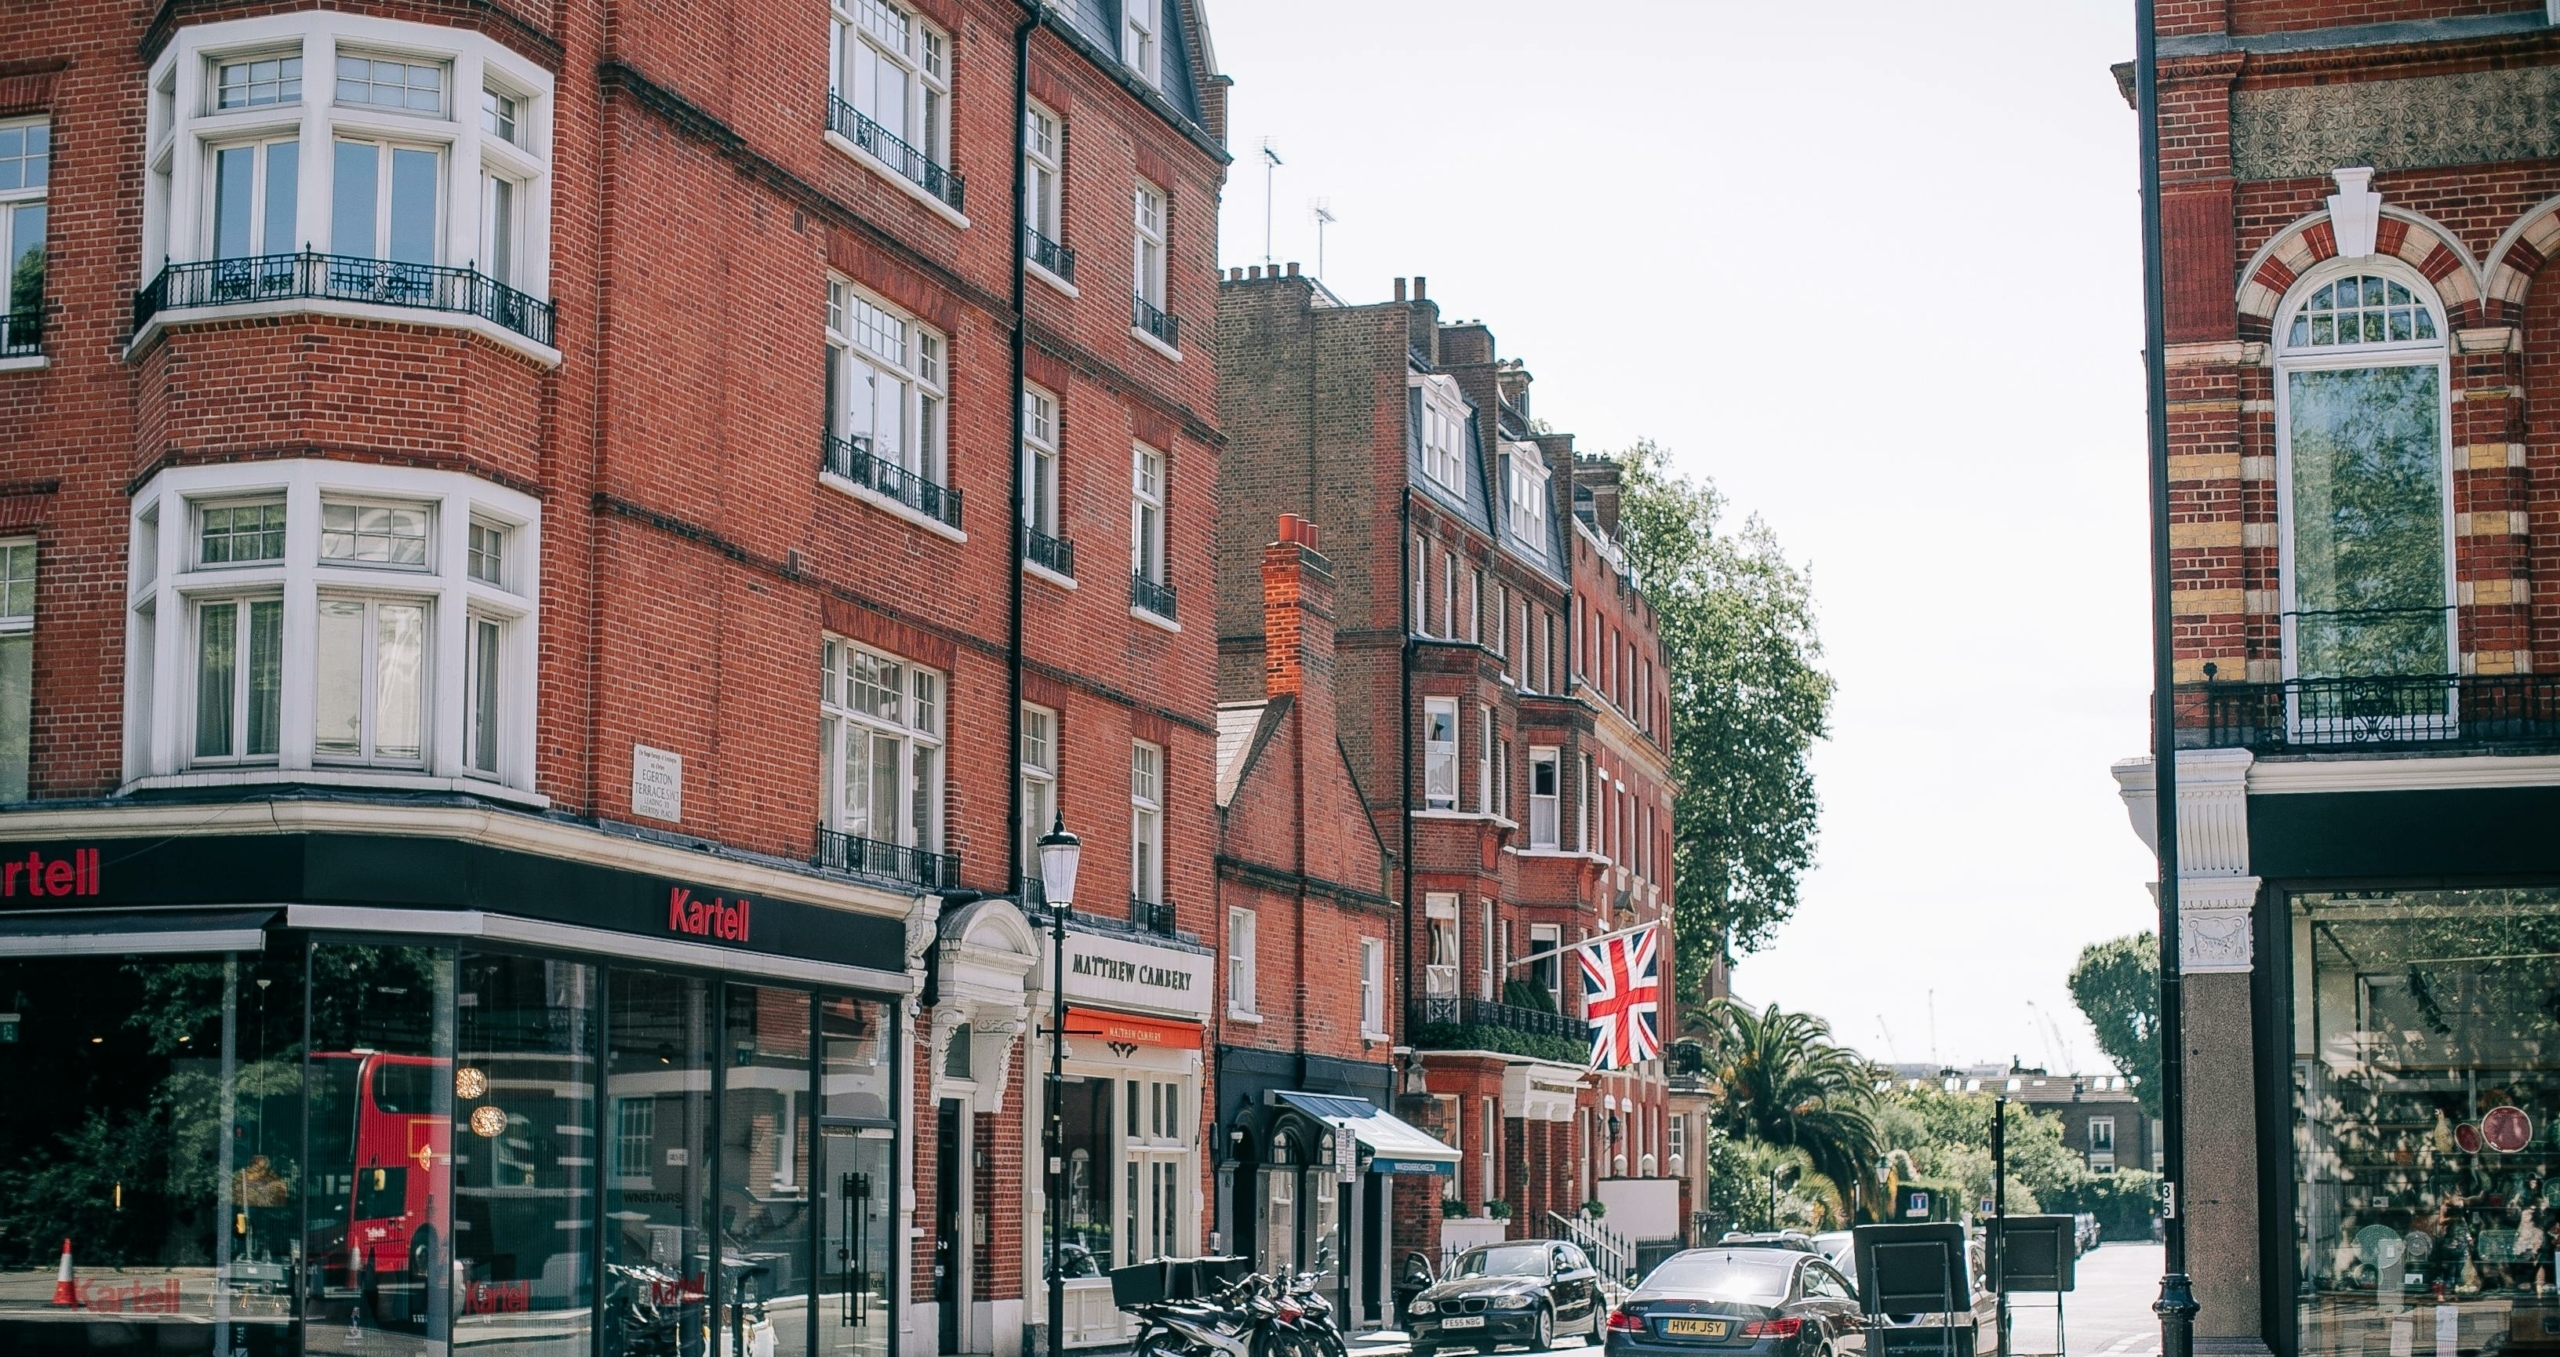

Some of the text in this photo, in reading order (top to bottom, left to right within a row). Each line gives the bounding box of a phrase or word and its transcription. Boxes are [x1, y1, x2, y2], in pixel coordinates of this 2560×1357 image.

[635, 782, 665, 800] TERRACE
[642, 769, 673, 786] EGERTON
[0, 848, 100, 897] rtell
[668, 887, 750, 942] Kartell
[1072, 954, 1192, 991] MATTHEW CAMBERY
[72, 1277, 180, 1314] Kartell
[465, 1280, 530, 1315] Kartell
[1672, 1320, 1722, 1333] HV14 JSY
